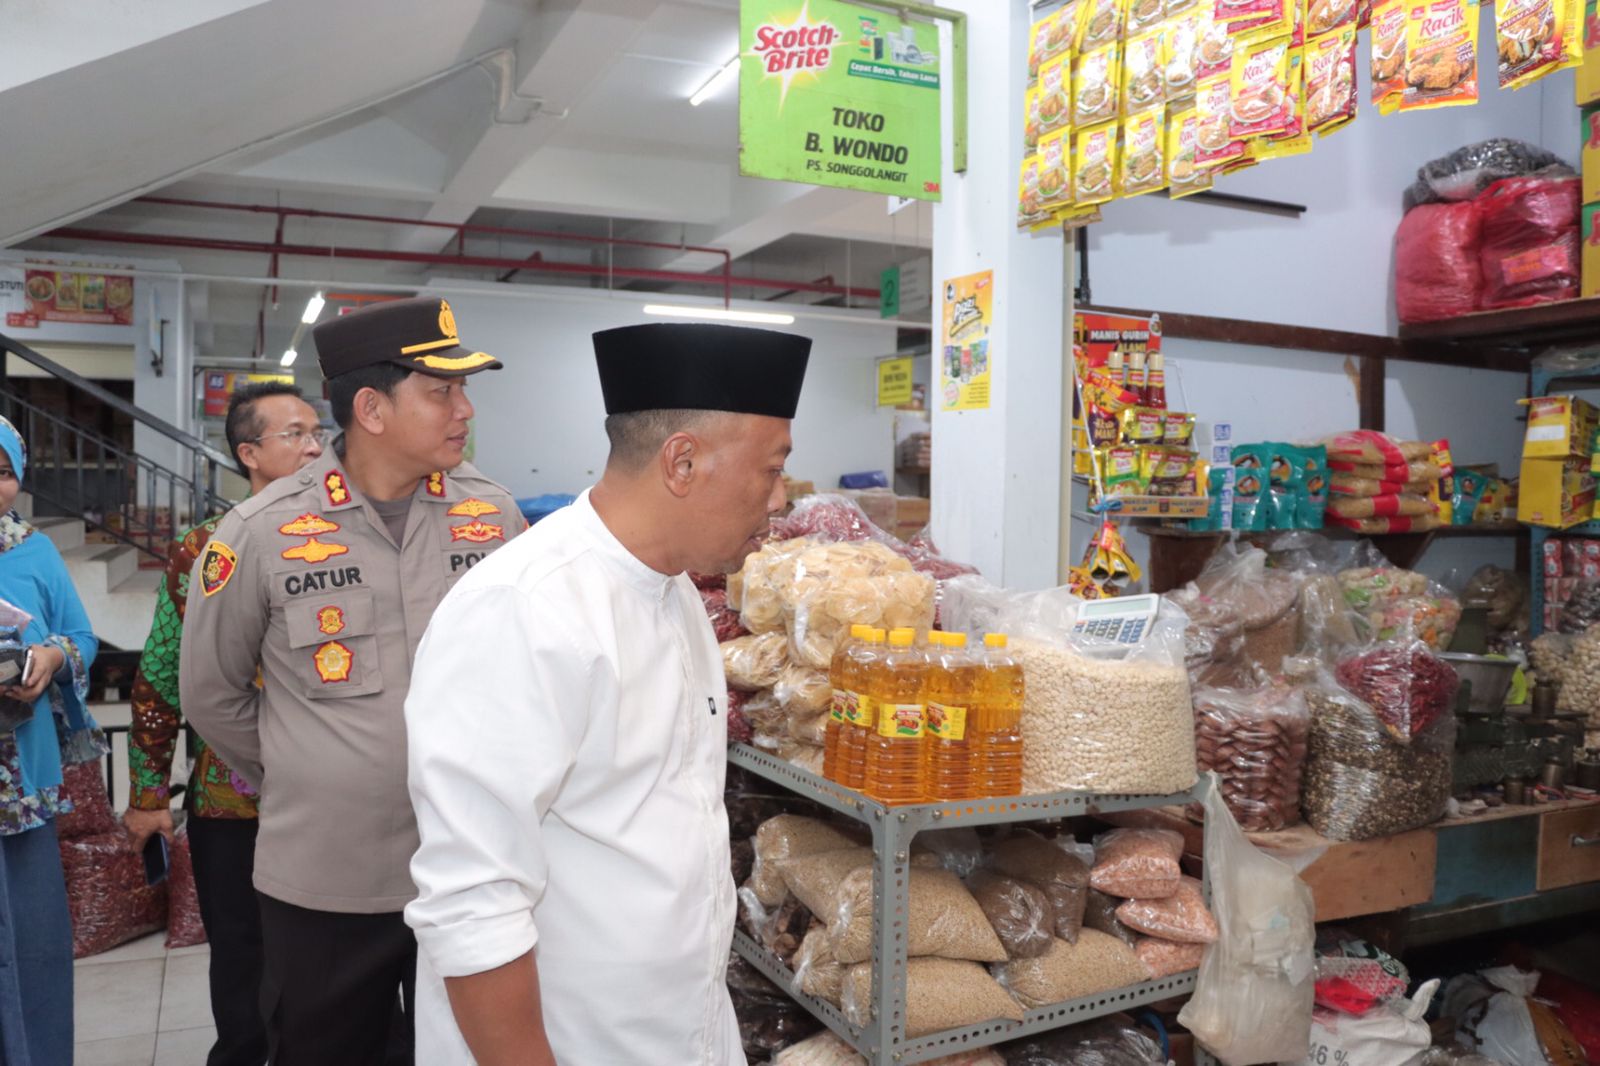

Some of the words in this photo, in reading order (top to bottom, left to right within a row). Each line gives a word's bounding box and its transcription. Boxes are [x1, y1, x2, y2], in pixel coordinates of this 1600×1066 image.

[1420, 7, 1464, 37] Racik
[764, 47, 829, 73] Brite
[832, 107, 885, 132] TOKO
[805, 132, 823, 153] B.
[833, 136, 909, 166] WONDO
[806, 159, 823, 171] PS.
[826, 162, 908, 183] SONGGOLANGIT
[923, 181, 940, 193] 3M
[1090, 330, 1120, 341] MANIS
[1122, 330, 1150, 341] GURIH
[450, 552, 486, 572] PO
[284, 566, 363, 596] CATUR
